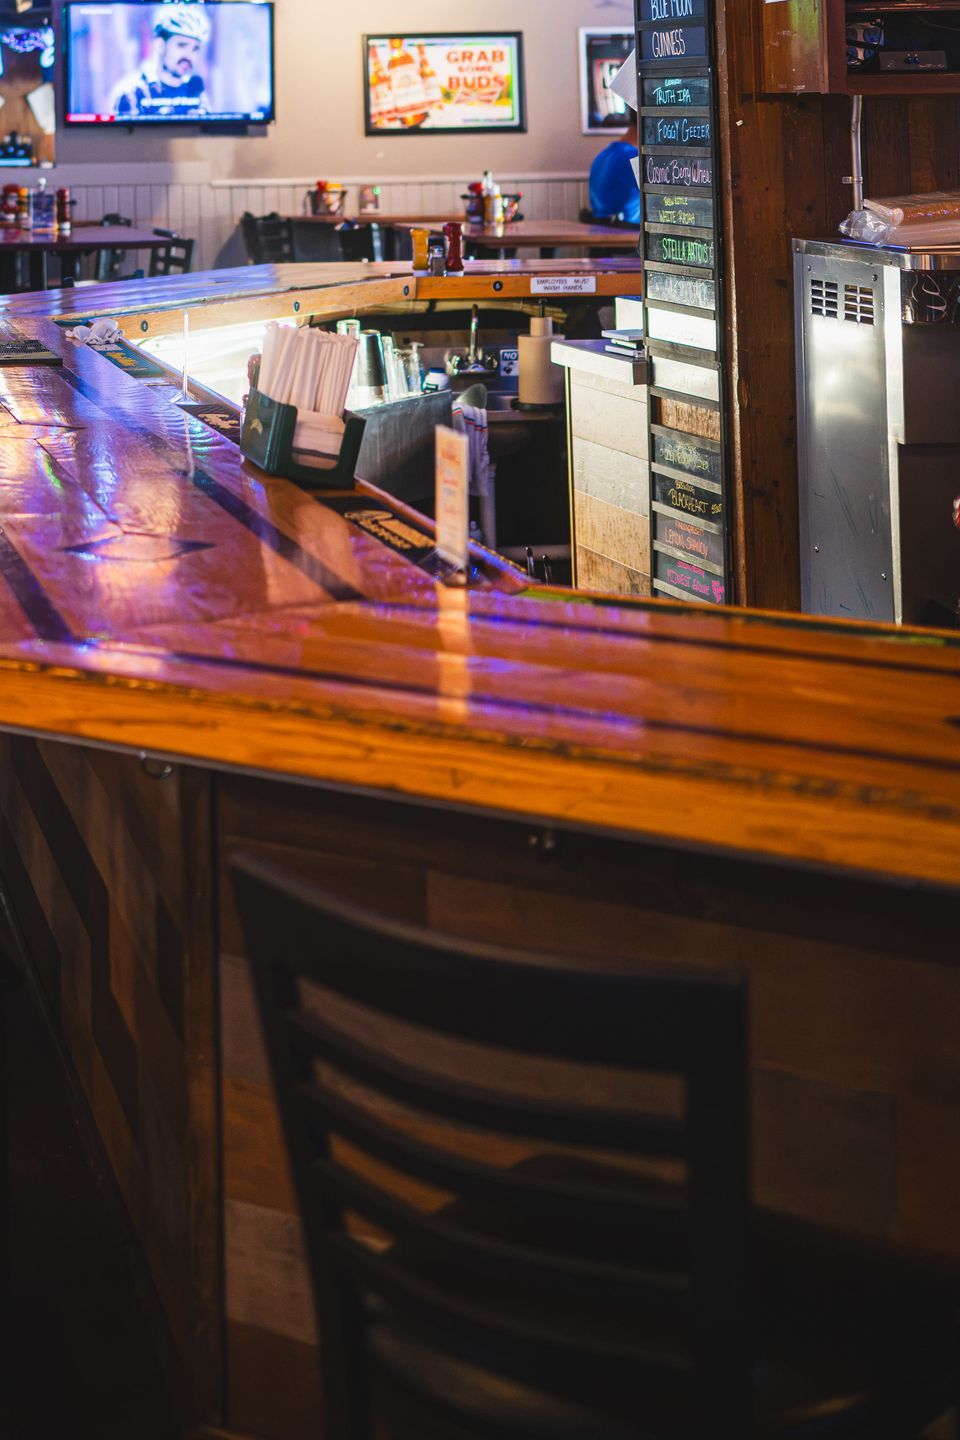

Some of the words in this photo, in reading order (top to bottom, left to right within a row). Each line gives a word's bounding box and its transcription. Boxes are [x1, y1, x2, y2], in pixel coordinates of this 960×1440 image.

[652, 28, 686, 58] GUINNESS
[446, 50, 504, 63] GRAB
[448, 75, 505, 89] BUDS
[652, 87, 676, 106] TRUTH
[677, 88, 691, 103] IPA
[657, 118, 680, 142] FOGGY
[682, 118, 710, 142] GEEZER
[647, 157, 671, 184] Cosmic
[669, 159, 691, 186] Berry
[662, 237, 686, 261] STELLA
